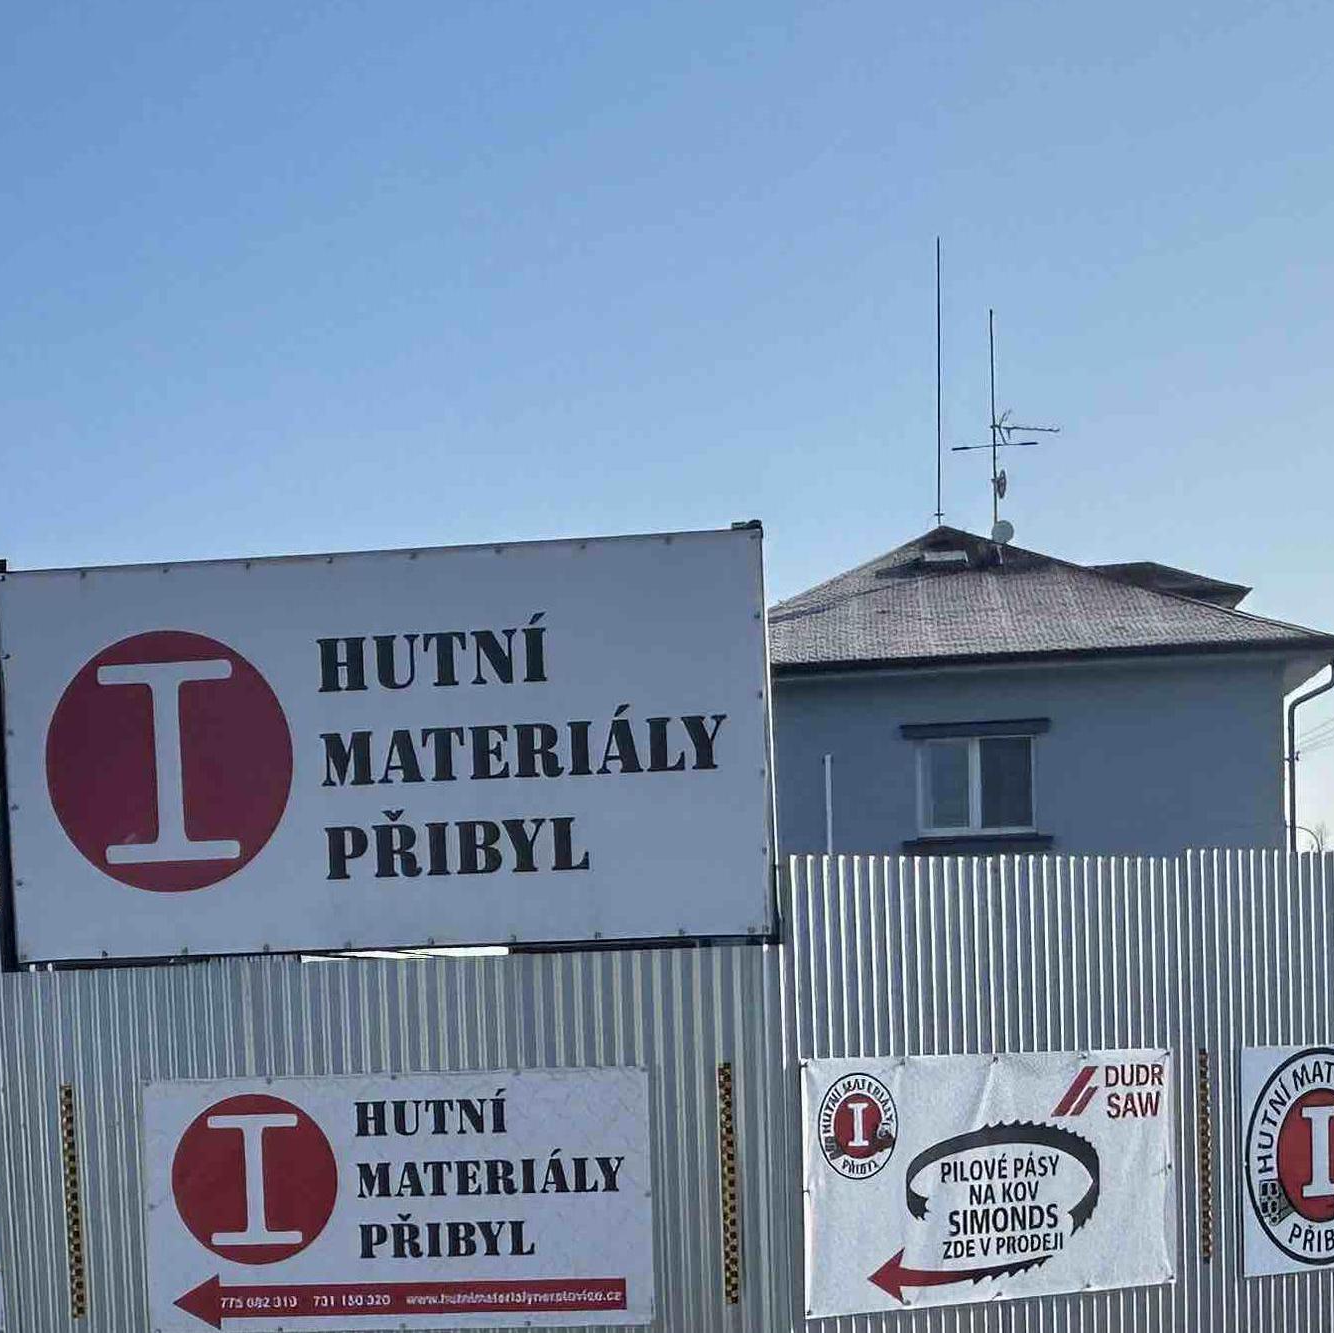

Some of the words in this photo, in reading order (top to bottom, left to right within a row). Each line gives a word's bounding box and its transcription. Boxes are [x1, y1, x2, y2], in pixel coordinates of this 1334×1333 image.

[316, 612, 549, 694] HUTNÍ
[320, 704, 728, 788] MATERIÁLY
[323, 809, 592, 881] PŘIBYL
[1104, 1064, 1164, 1088] DUDR
[355, 1088, 508, 1137] HUTNÍ
[1106, 1091, 1162, 1119] SAW
[357, 1148, 626, 1198] MATERIÁLY
[940, 1153, 1009, 1184] PILOVÉ
[1013, 1150, 1061, 1177] PÁSY
[969, 1185, 996, 1206] NA
[1001, 1181, 1040, 1204] KOV
[359, 1213, 536, 1259] PŘIBYL
[948, 1204, 1059, 1237] SIMONDS
[942, 1240, 976, 1260] ZDE
[980, 1239, 992, 1257] V
[995, 1232, 1064, 1254] PRODEJI
